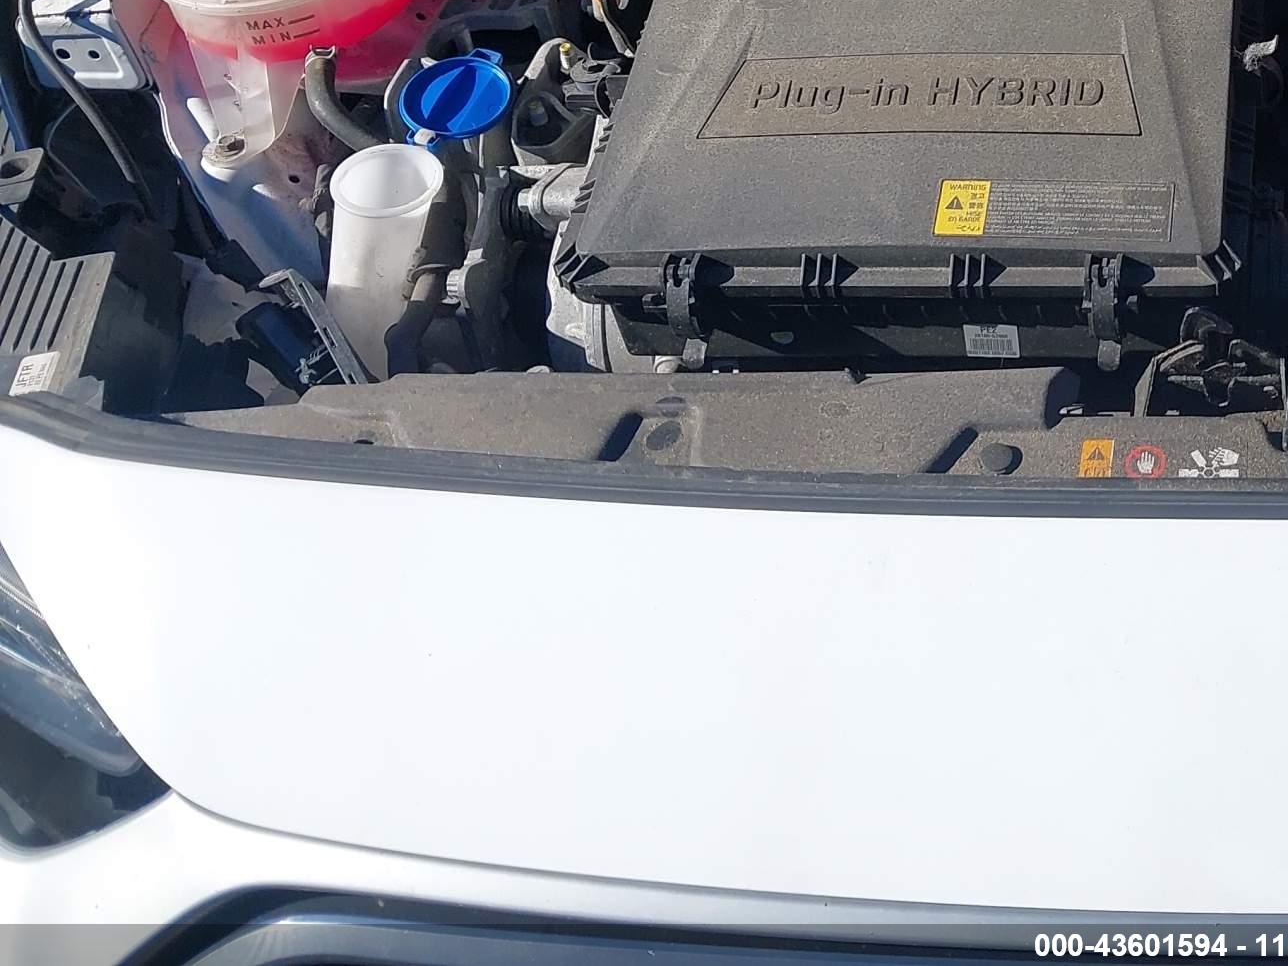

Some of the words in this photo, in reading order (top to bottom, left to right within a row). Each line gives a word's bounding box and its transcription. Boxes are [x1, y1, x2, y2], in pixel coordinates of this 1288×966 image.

[246, 17, 285, 31] MAX
[251, 31, 292, 46] MIN
[752, 77, 910, 115] Plug-in
[926, 76, 1105, 107] HYBRID
